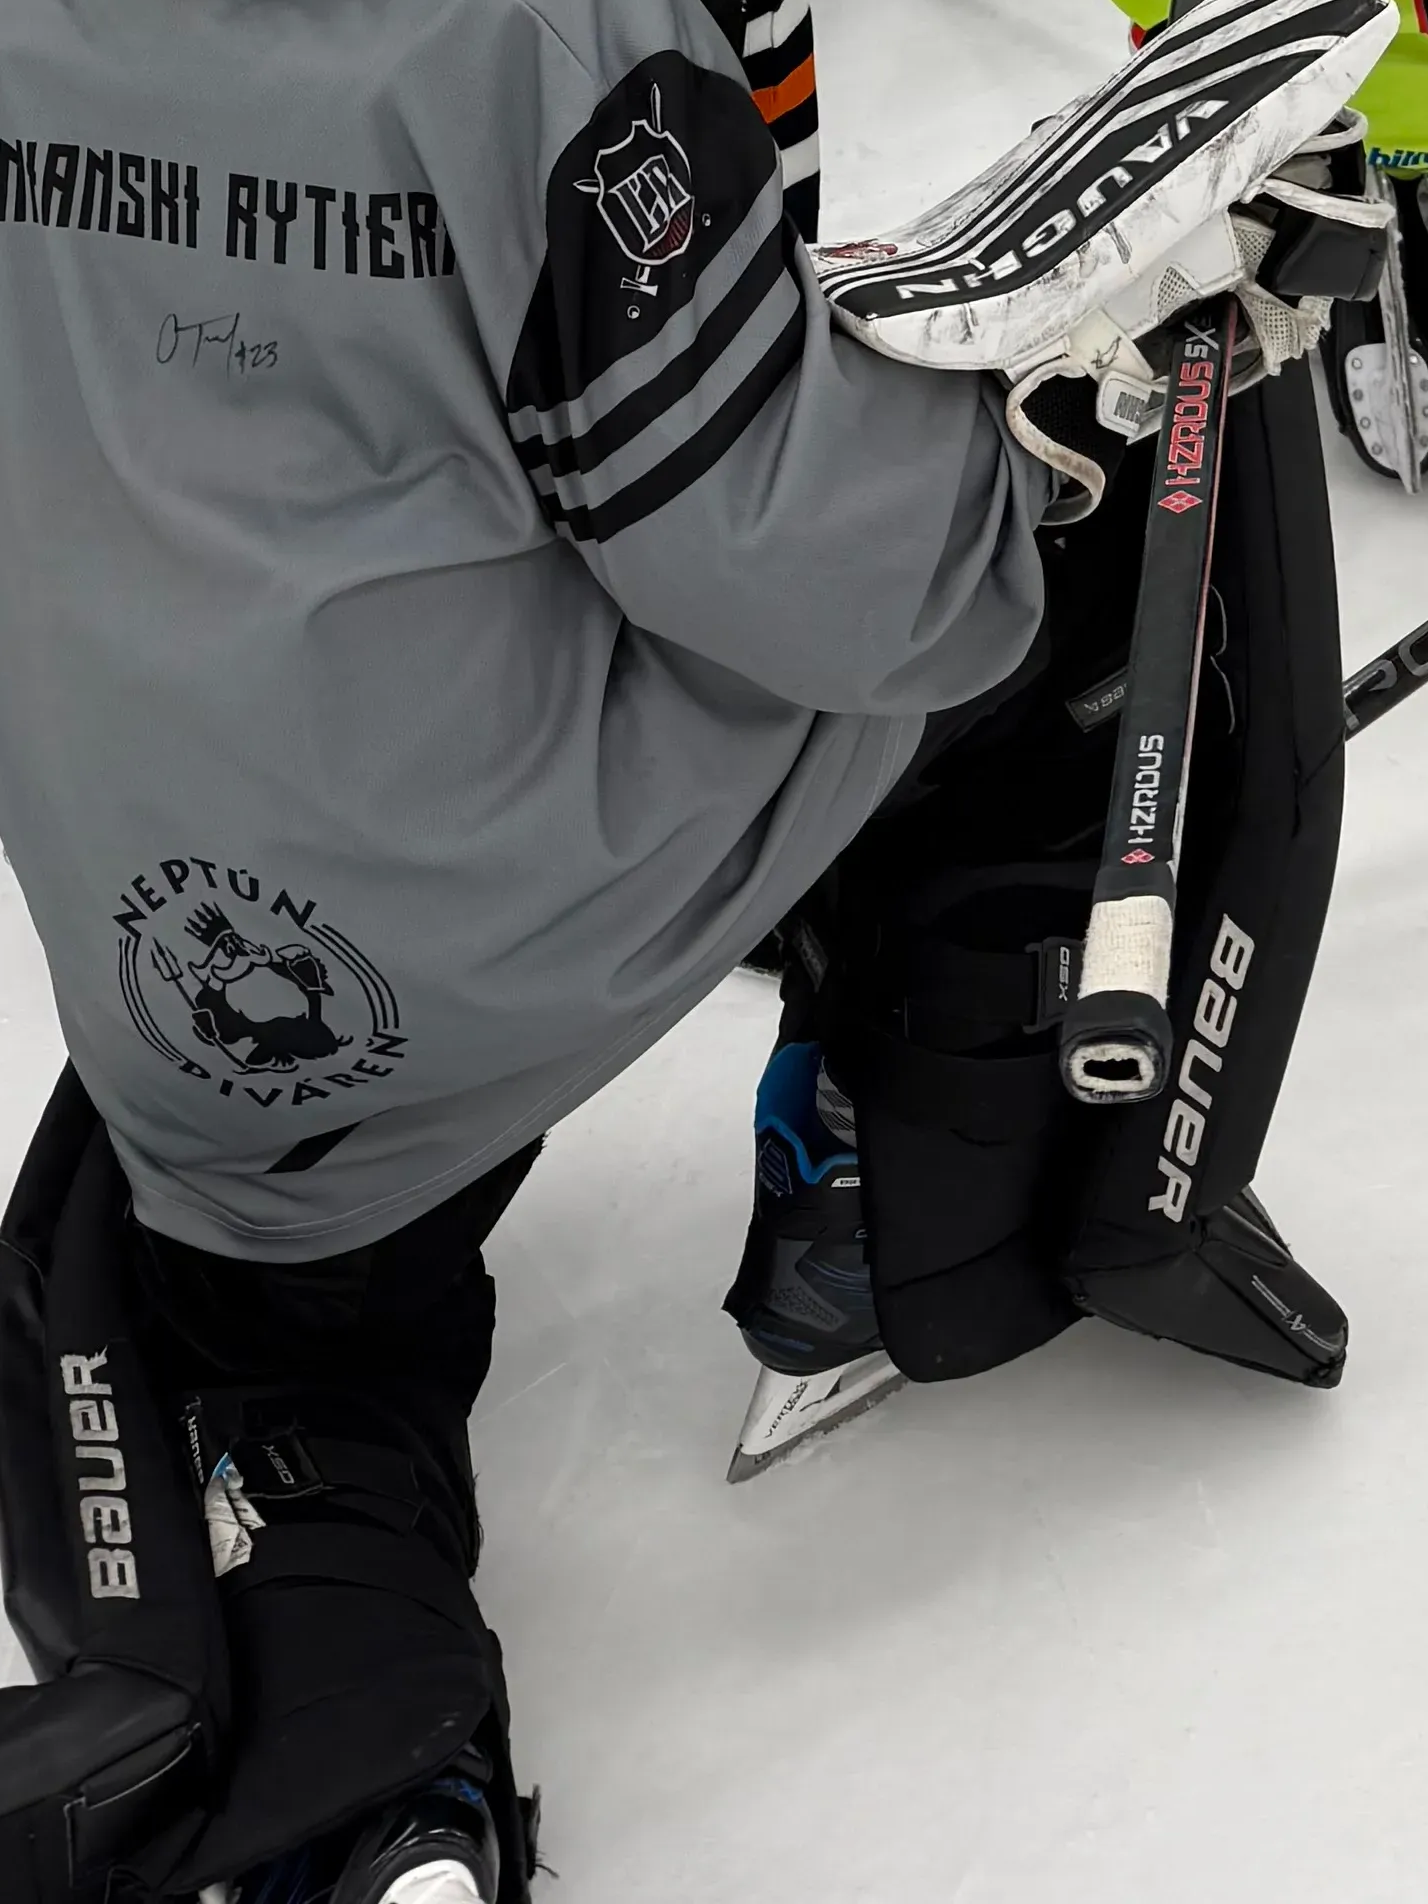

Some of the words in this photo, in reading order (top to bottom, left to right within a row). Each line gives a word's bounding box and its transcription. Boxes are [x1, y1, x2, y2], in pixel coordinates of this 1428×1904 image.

[225, 172, 458, 280] RYTIER
[893, 96, 1232, 305] VAUGHN
[113, 854, 318, 940] NEPTÚN
[1147, 911, 1256, 1224] BAUER
[59, 1344, 140, 1600] BAUER
